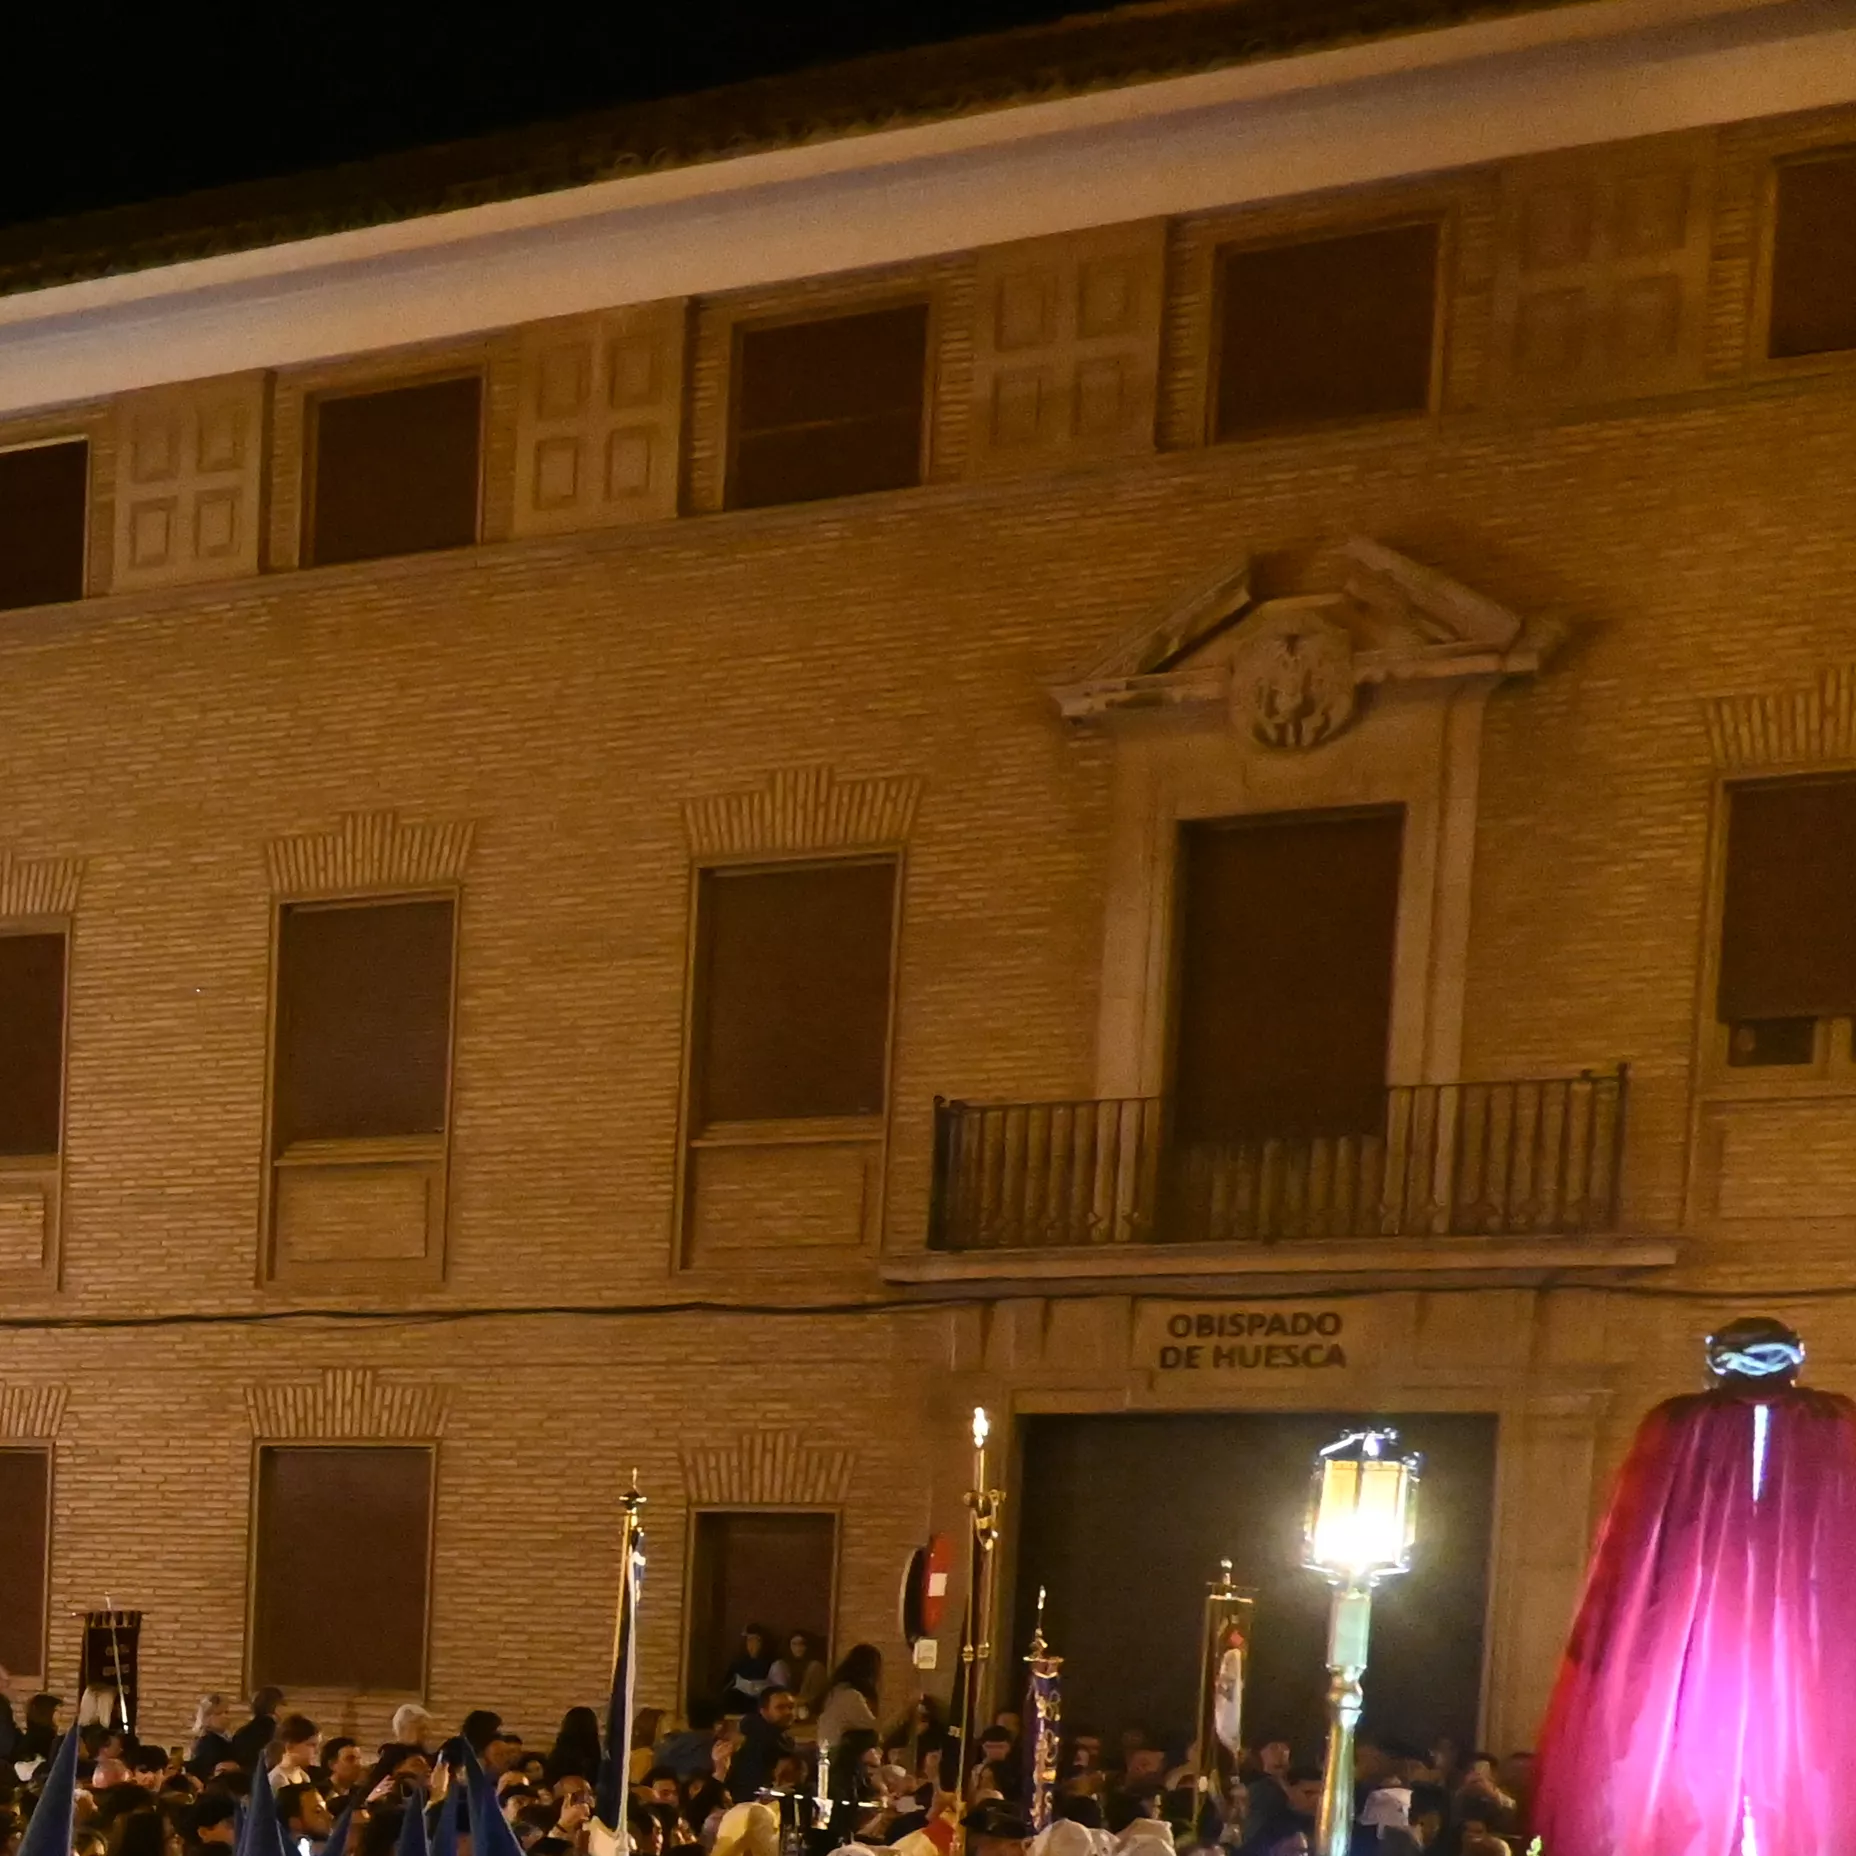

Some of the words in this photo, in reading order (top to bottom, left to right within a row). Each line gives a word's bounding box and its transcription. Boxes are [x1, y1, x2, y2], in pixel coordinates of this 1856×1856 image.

[1167, 1312, 1344, 1338] OBISPADO
[1159, 1346, 1204, 1369] DE
[1212, 1344, 1347, 1369] HUESCA
